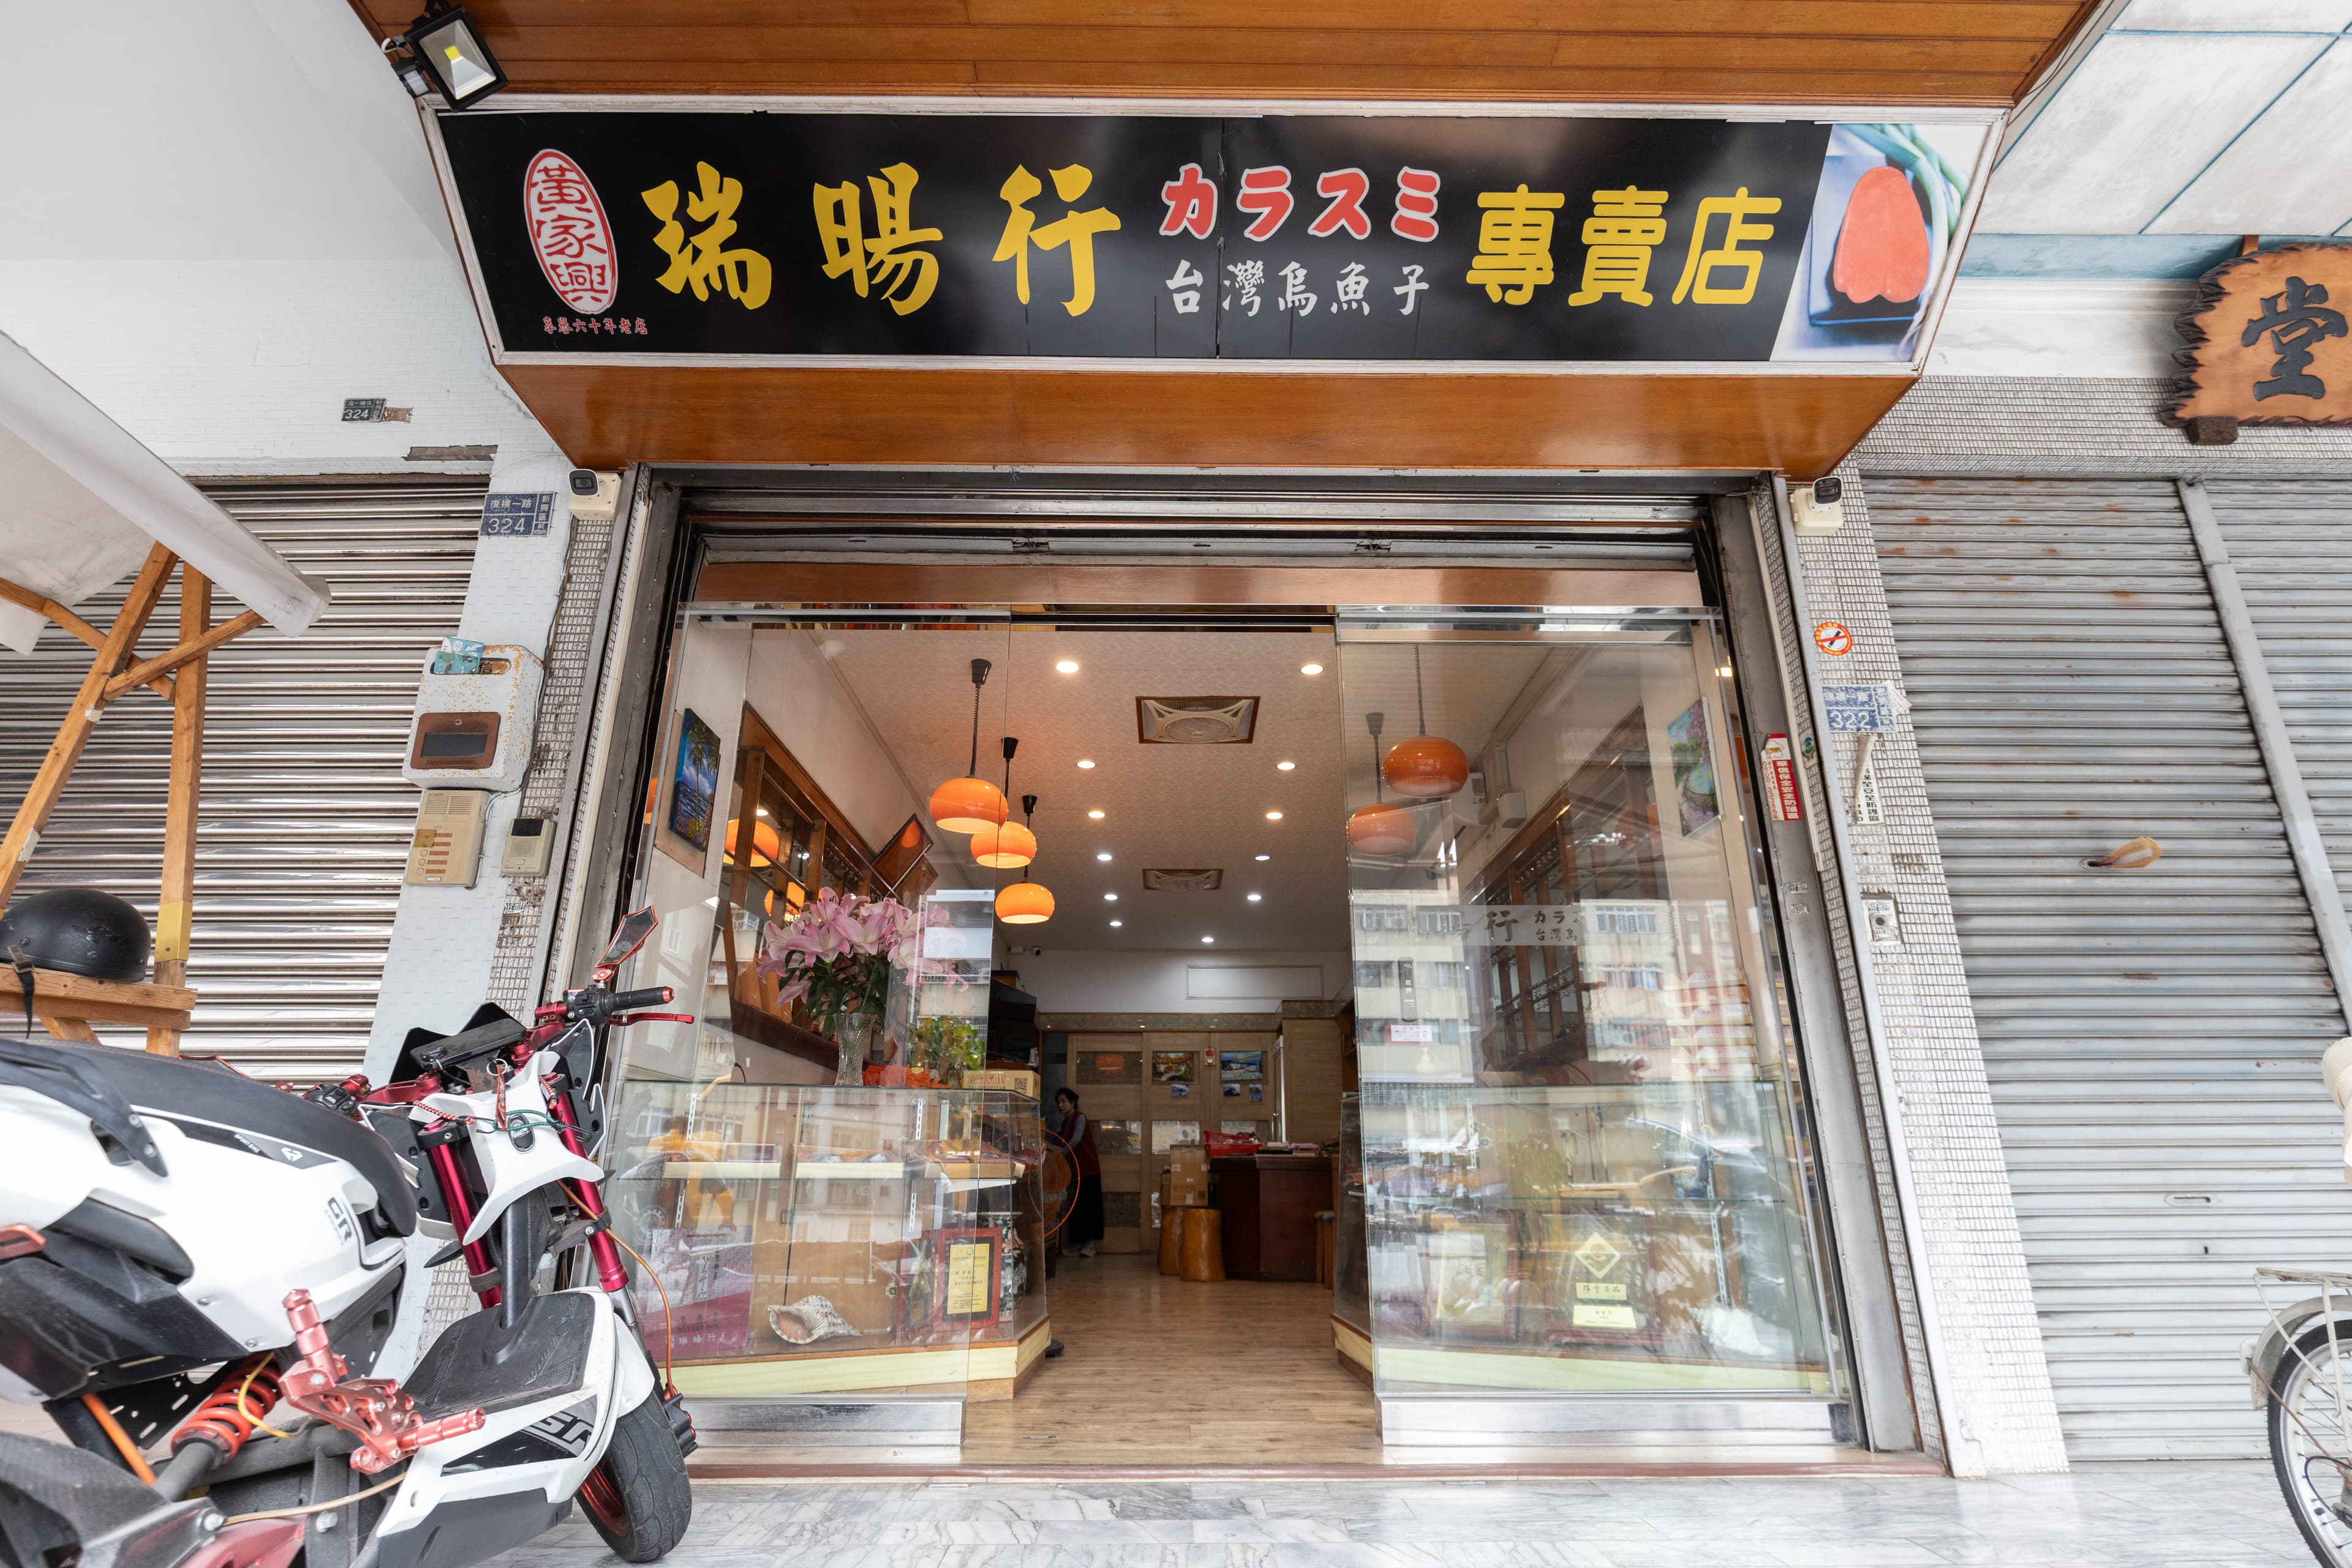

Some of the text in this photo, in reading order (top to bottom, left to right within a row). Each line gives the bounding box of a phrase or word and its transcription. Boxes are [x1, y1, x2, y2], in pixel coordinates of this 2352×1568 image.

[1159, 163, 1441, 242] カラスミ
[1466, 184, 1782, 307] 專賣店
[543, 316, 647, 334] 享譽六十年老店
[2241, 276, 2348, 401] 堂
[345, 409, 369, 419] 324
[488, 518, 525, 533] 324
[1830, 712, 1872, 728] 322
